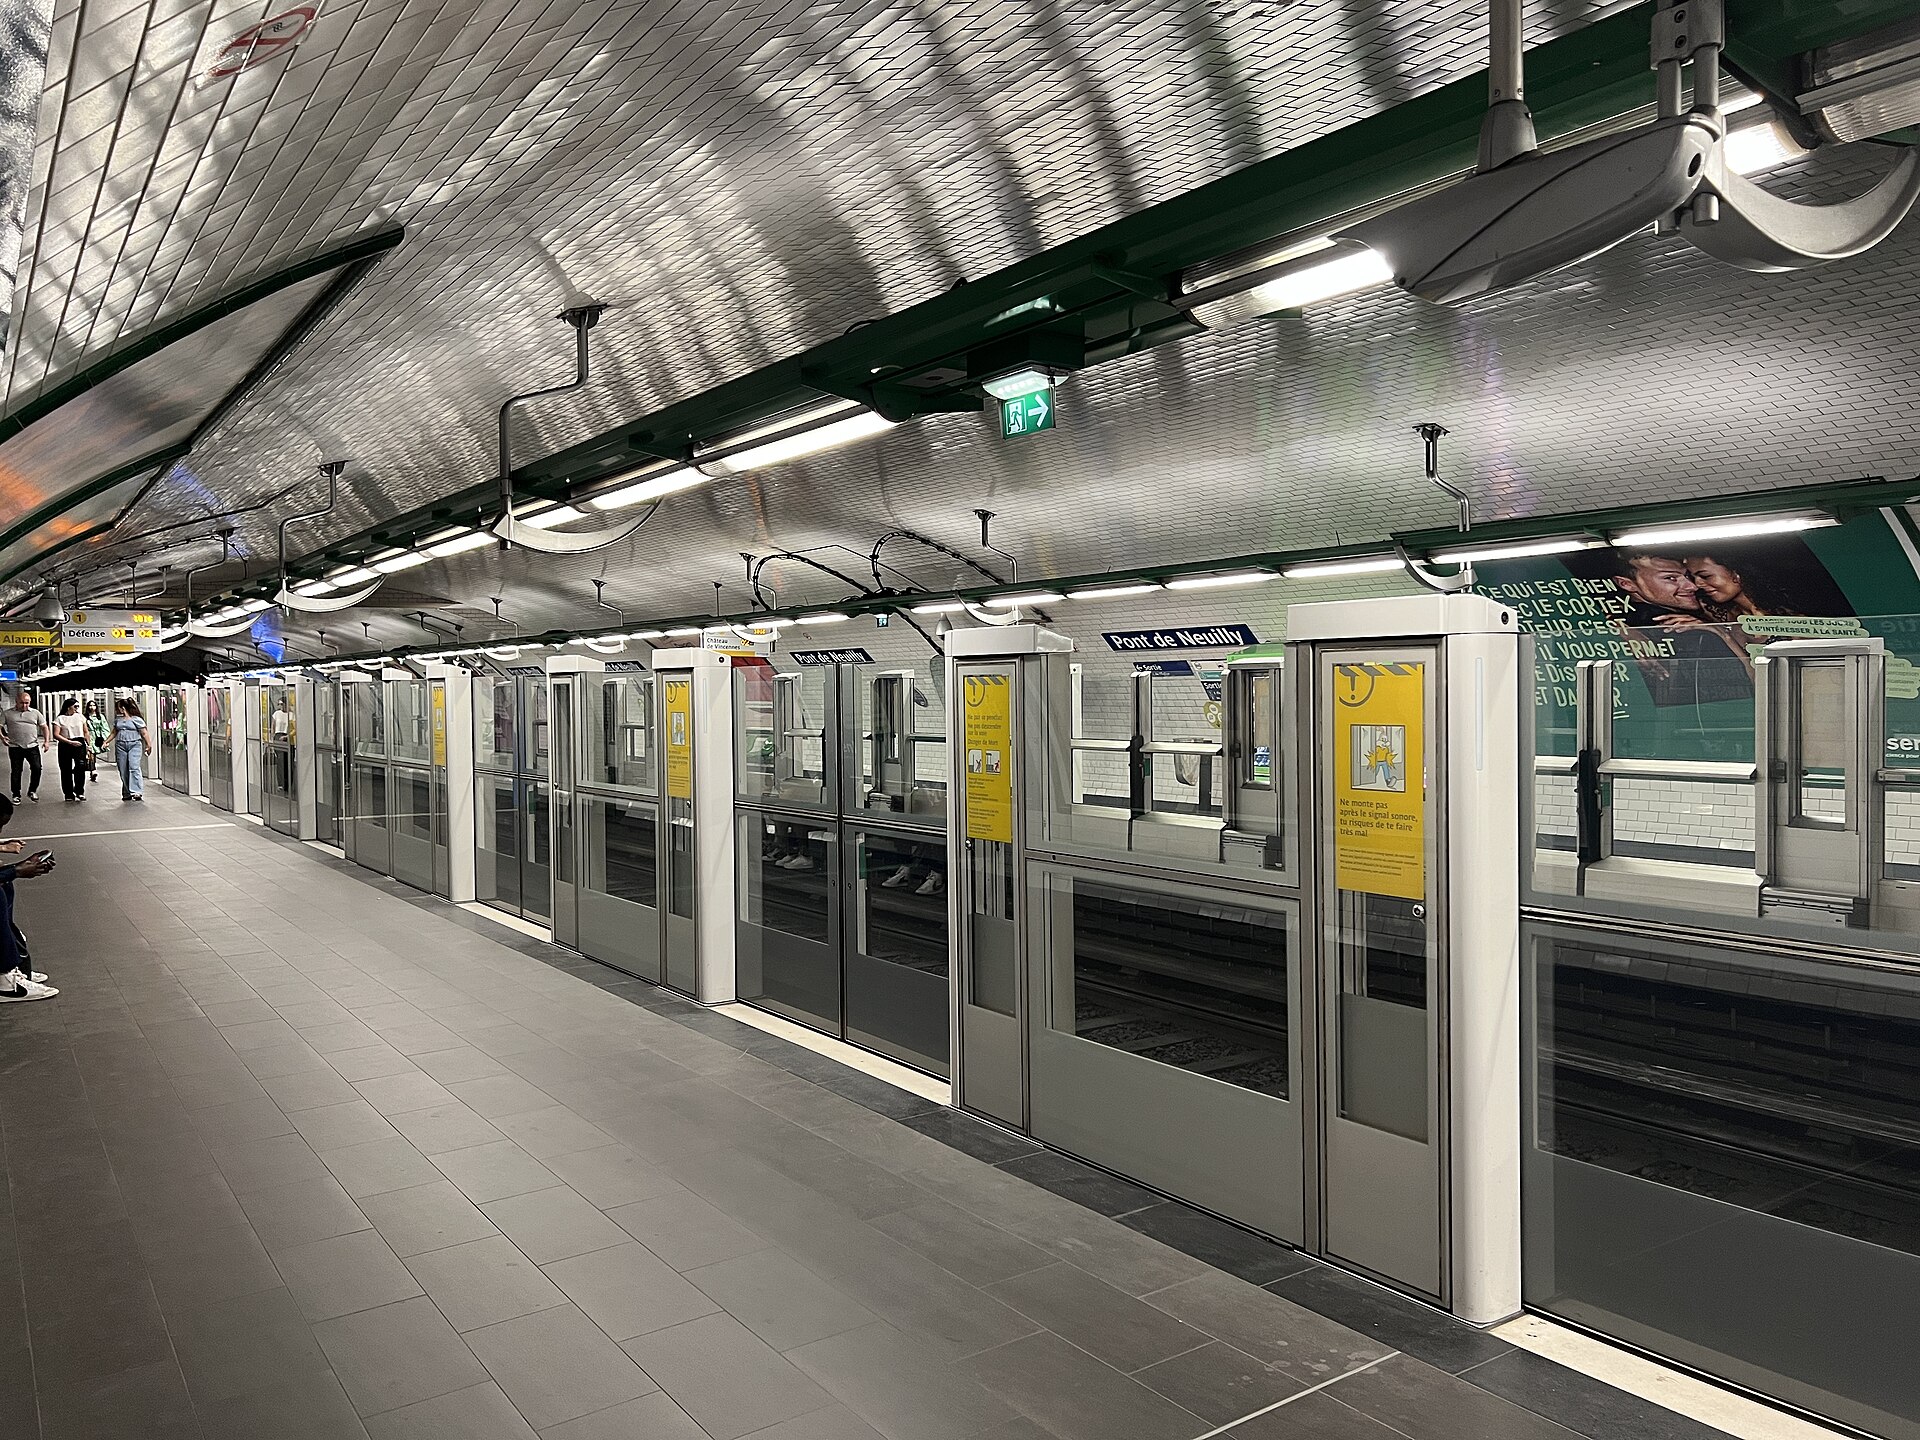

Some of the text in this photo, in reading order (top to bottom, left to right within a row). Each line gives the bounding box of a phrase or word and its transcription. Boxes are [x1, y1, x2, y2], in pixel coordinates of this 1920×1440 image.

[1534, 579, 1571, 595] EST
[1536, 599, 1554, 617] LE
[1556, 595, 1636, 616] CORTEX
[1577, 617, 1629, 636] C'EST
[1754, 626, 1811, 634] S'INTÉRESSER
[2, 635, 45, 645] Alarme
[69, 630, 106, 638] Défense
[1110, 628, 1244, 650] Pont de Neuilly
[1556, 641, 1608, 660] VOUS
[1608, 638, 1676, 660] PERMET
[794, 649, 867, 664] Pont de Neuilly
[1535, 665, 1546, 681] E
[1340, 798, 1389, 810] Ne monte pas
[1340, 809, 1359, 817] après
[1368, 811, 1389, 820] signal
[1391, 813, 1418, 823] sonore,
[1340, 818, 1413, 832] tu risques de te faire
[1340, 828, 1368, 837] très mal
